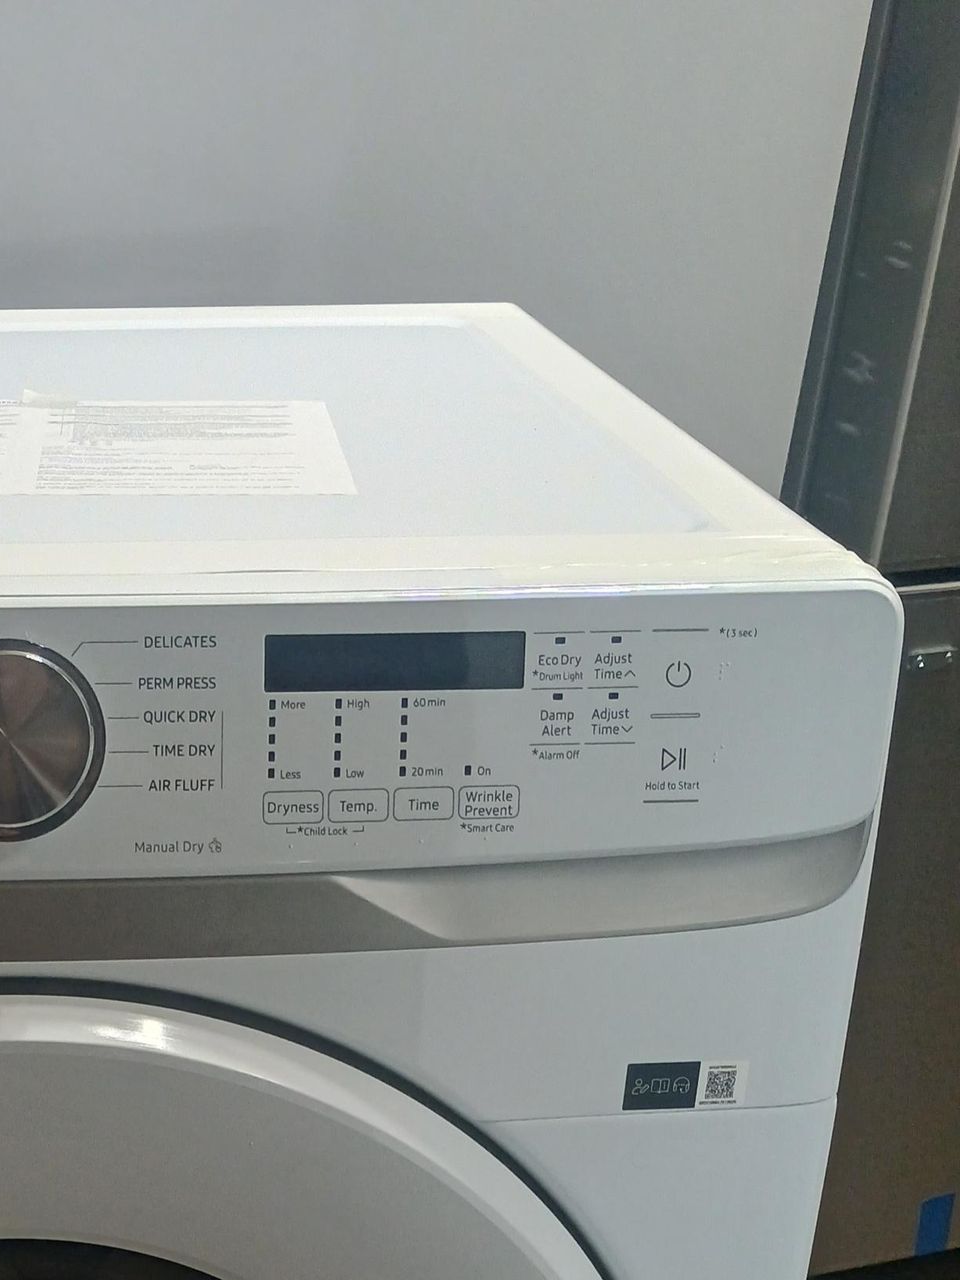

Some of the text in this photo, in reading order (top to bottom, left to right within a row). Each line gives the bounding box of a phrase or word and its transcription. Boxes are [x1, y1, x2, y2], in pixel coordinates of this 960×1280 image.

[144, 635, 216, 649] DELICATES
[538, 654, 581, 668] Eco Dry
[594, 652, 632, 667] Adjust
[562, 670, 583, 683] Light
[594, 668, 622, 680] Time
[138, 676, 216, 690] PERM PRESS
[280, 699, 305, 710] More
[346, 698, 369, 711] High
[143, 709, 215, 726] QUICK DRY
[540, 709, 574, 723] Damp
[591, 707, 629, 723] Adjust
[541, 724, 571, 737] Alert
[591, 723, 619, 735] Time
[152, 743, 215, 757] TIME DRY
[565, 749, 579, 760] Off
[280, 769, 301, 780] Less
[345, 768, 364, 779] Low
[477, 765, 491, 776] On
[148, 778, 215, 792] AIR FLUFF
[644, 780, 699, 791] Hold to Start
[465, 789, 512, 803] Wrinkle
[267, 801, 319, 817] Dryness
[339, 800, 377, 815] Temp.
[408, 798, 439, 812] Time
[463, 804, 513, 819] Prevent
[327, 825, 347, 836] Lock
[494, 823, 514, 833] Care
[134, 839, 204, 856] Manual Dry
